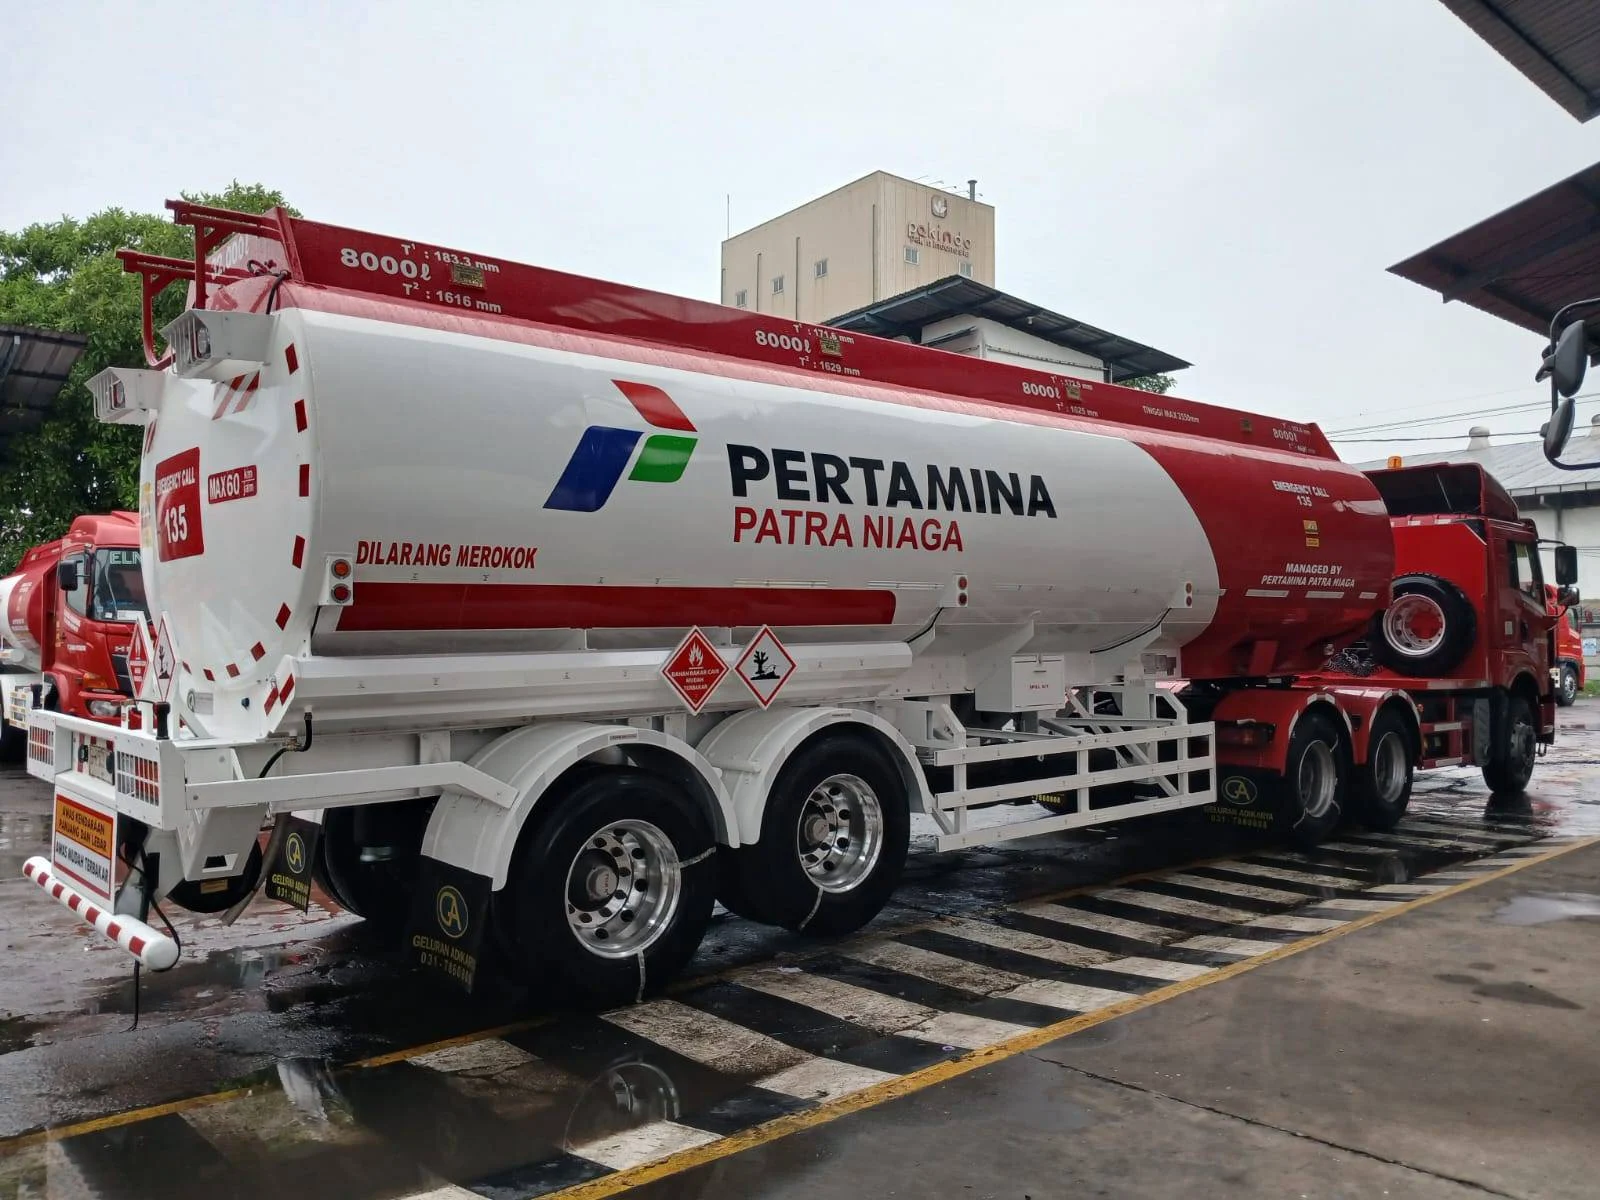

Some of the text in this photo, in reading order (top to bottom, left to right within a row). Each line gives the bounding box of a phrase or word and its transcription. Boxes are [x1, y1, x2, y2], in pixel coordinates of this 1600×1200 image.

[434, 250, 472, 267] 183.3
[475, 261, 500, 273] mm
[436, 290, 472, 308] 1616
[476, 302, 502, 314] mm
[839, 335, 855, 345] mm
[820, 361, 841, 373] 1629
[844, 366, 860, 377] mm
[157, 467, 196, 496] EMERGENCY CALL
[726, 443, 1058, 518] PERTAMINA
[1272, 480, 1330, 498] EMERGENCY CALL
[1297, 495, 1313, 507] 135
[165, 504, 188, 543] 135
[733, 506, 964, 552] PATRA NIAGA
[356, 540, 538, 569] DILARANG MEROKOK
[1285, 563, 1342, 575] MANAGED BY
[1261, 575, 1355, 588] PERTAMINA PATRA NIAGA
[56, 840, 68, 858] AWAS
[85, 857, 109, 883] TERBAKAR
